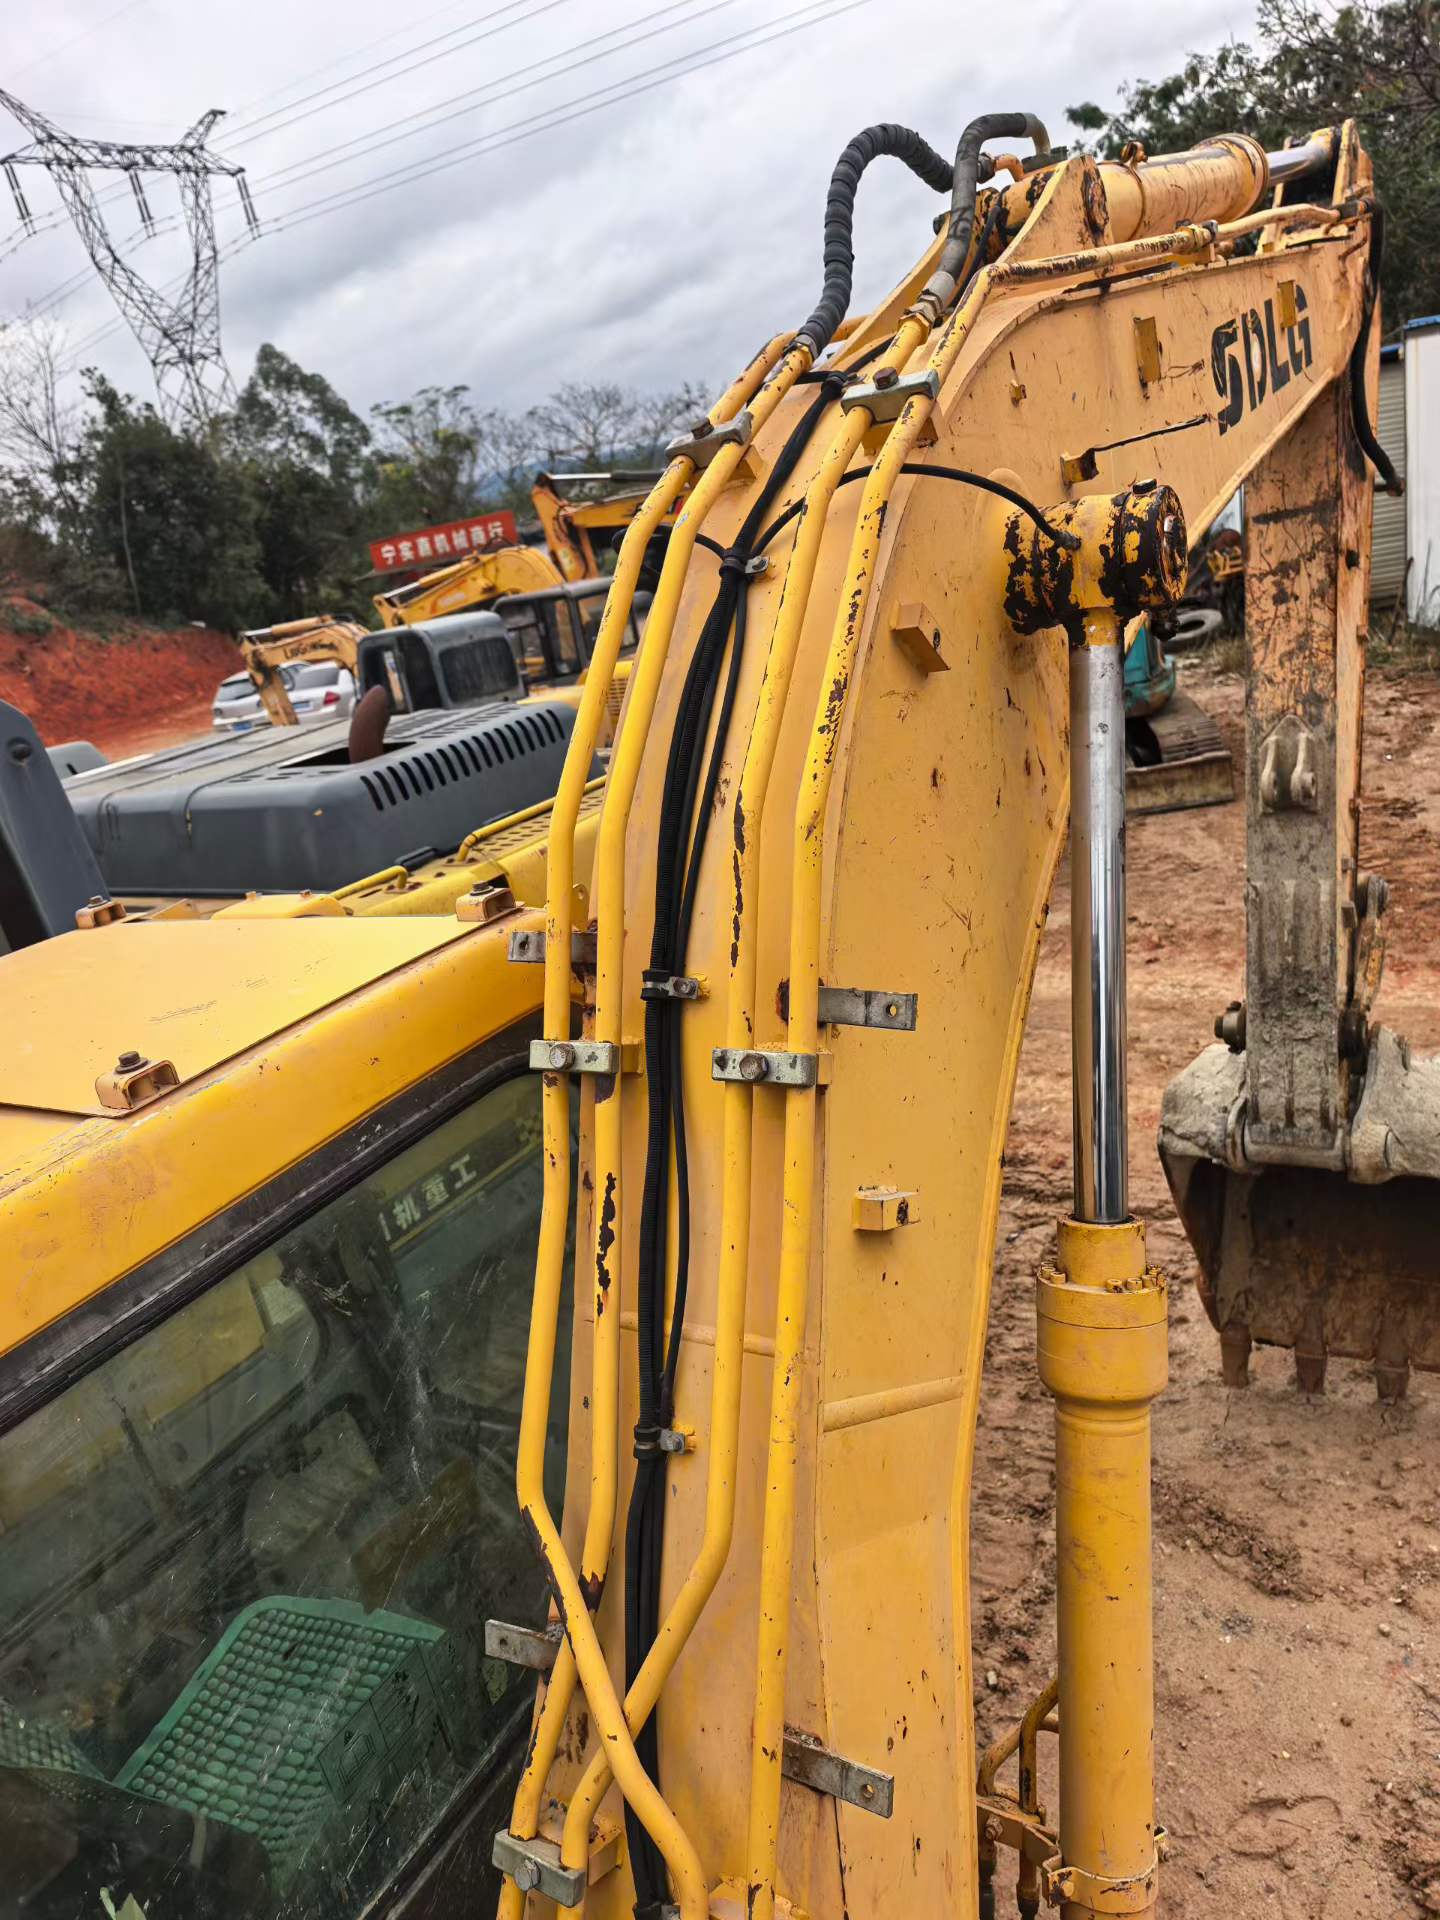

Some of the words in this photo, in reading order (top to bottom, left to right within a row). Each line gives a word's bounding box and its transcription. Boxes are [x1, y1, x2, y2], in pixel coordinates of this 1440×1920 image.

[1211, 284, 1313, 436] SDLG
[378, 1153, 477, 1241] 机重工
